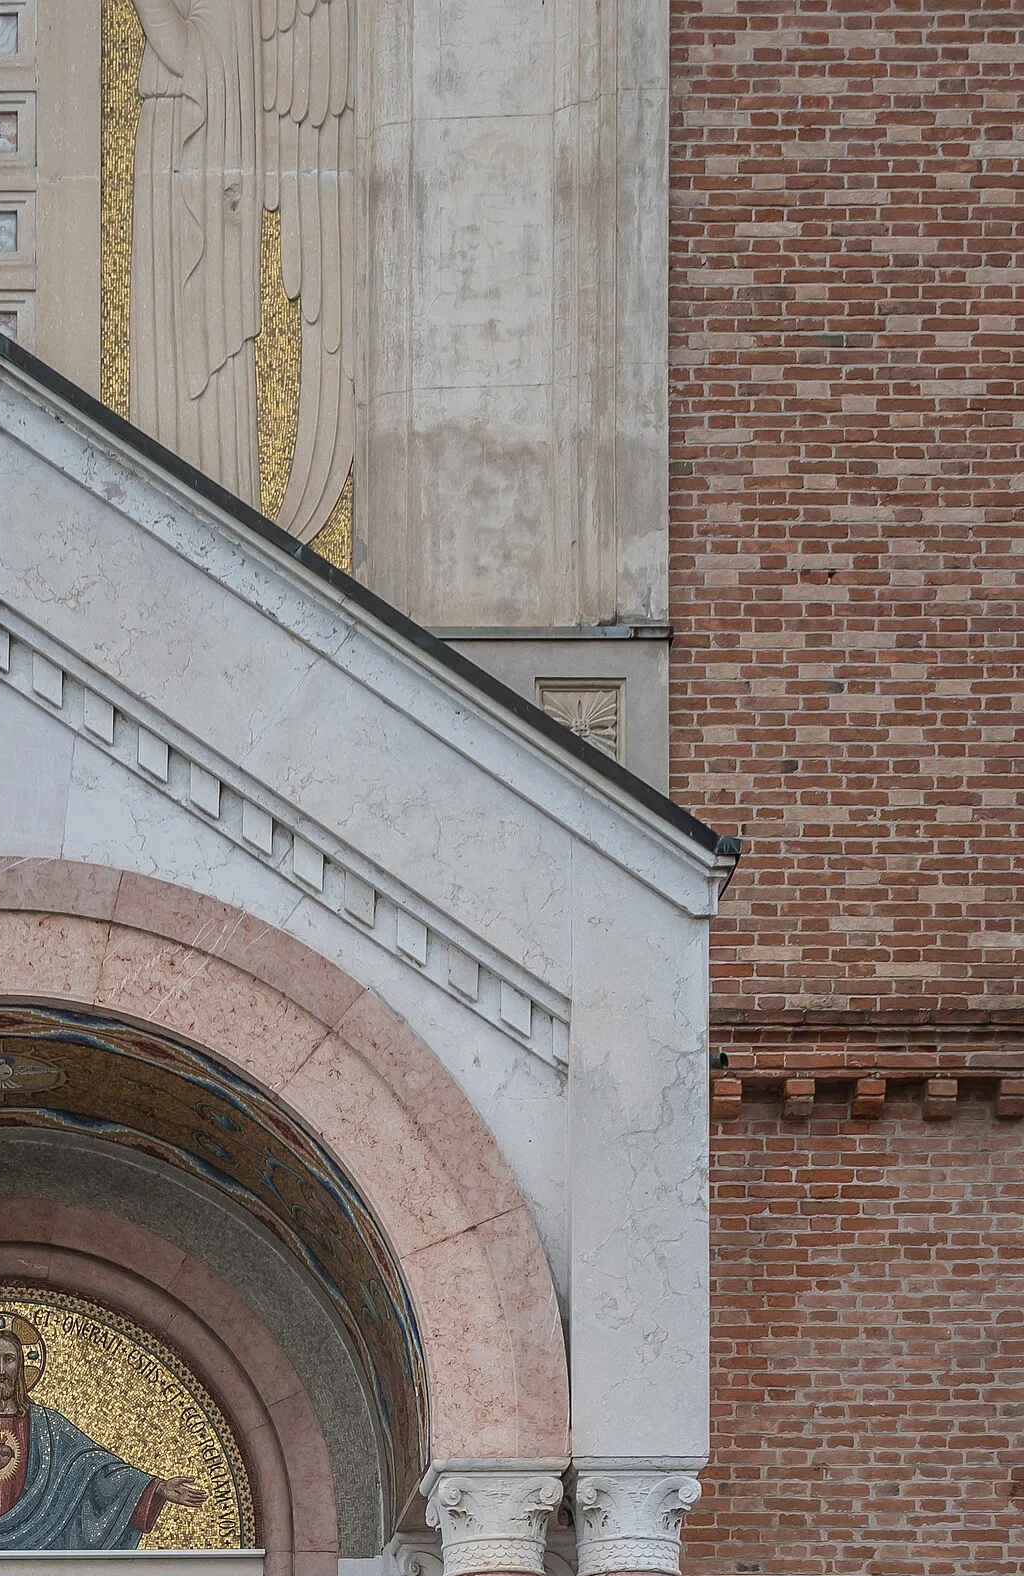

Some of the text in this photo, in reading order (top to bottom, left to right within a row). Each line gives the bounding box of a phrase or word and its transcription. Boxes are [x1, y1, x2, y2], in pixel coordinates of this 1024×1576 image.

[33, 1308, 54, 1328] ET
[62, 1315, 123, 1355] ONERATI
[127, 1349, 166, 1384] ESTIS
[163, 1383, 185, 1404] ET
[181, 1406, 206, 1434] EGO
[198, 1437, 234, 1506] REFICIAM
[218, 1510, 236, 1538] VOS
